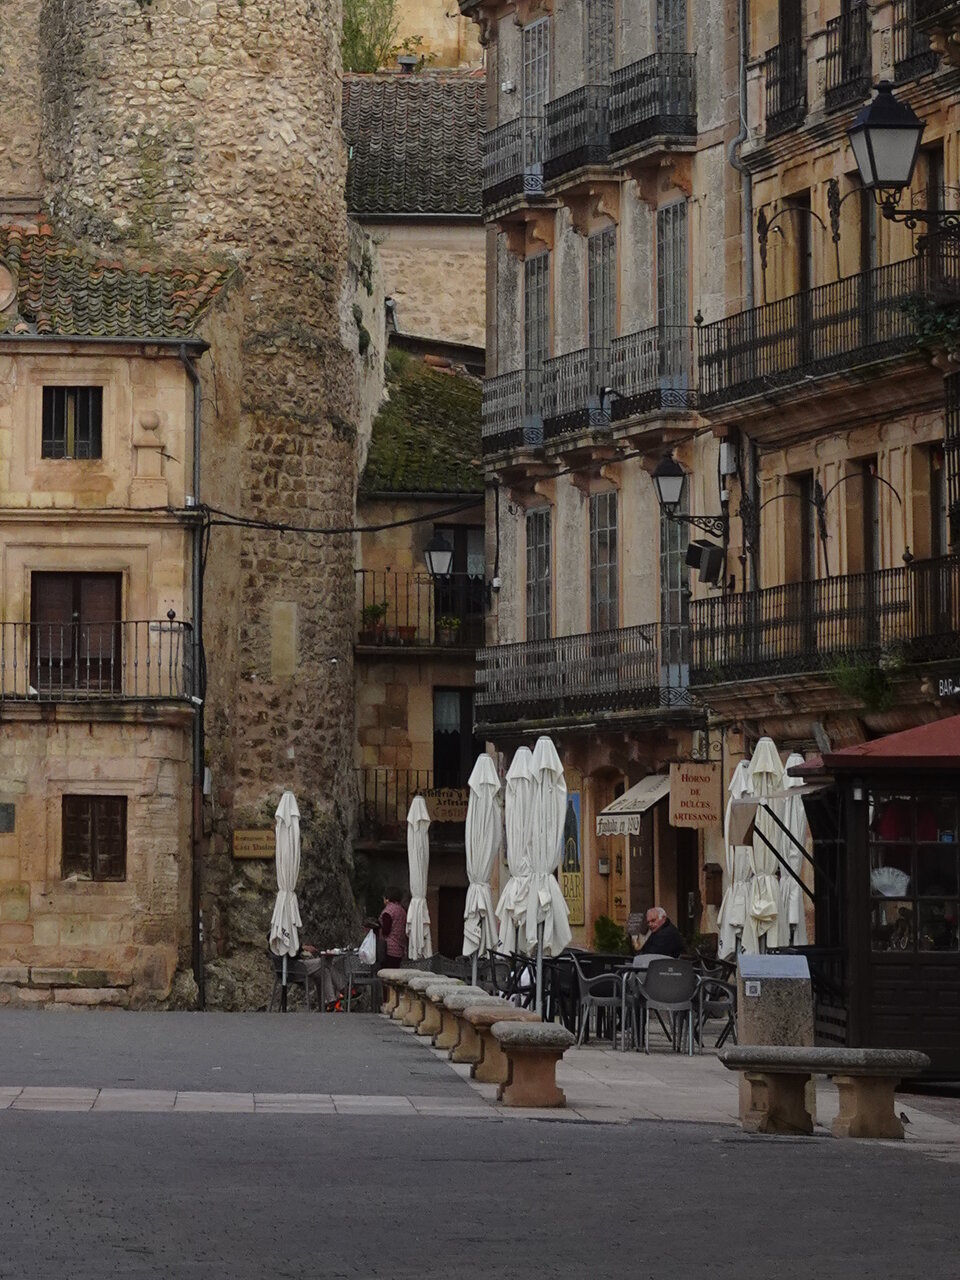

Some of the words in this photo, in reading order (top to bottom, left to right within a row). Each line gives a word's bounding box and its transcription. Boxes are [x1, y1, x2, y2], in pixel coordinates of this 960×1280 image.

[939, 678, 953, 697] BAR
[681, 773, 711, 783] HORNO
[690, 788, 701, 796] DE
[680, 800, 711, 809] DULCES
[674, 813, 718, 822] ARTESANOS
[562, 874, 581, 898] BAR
